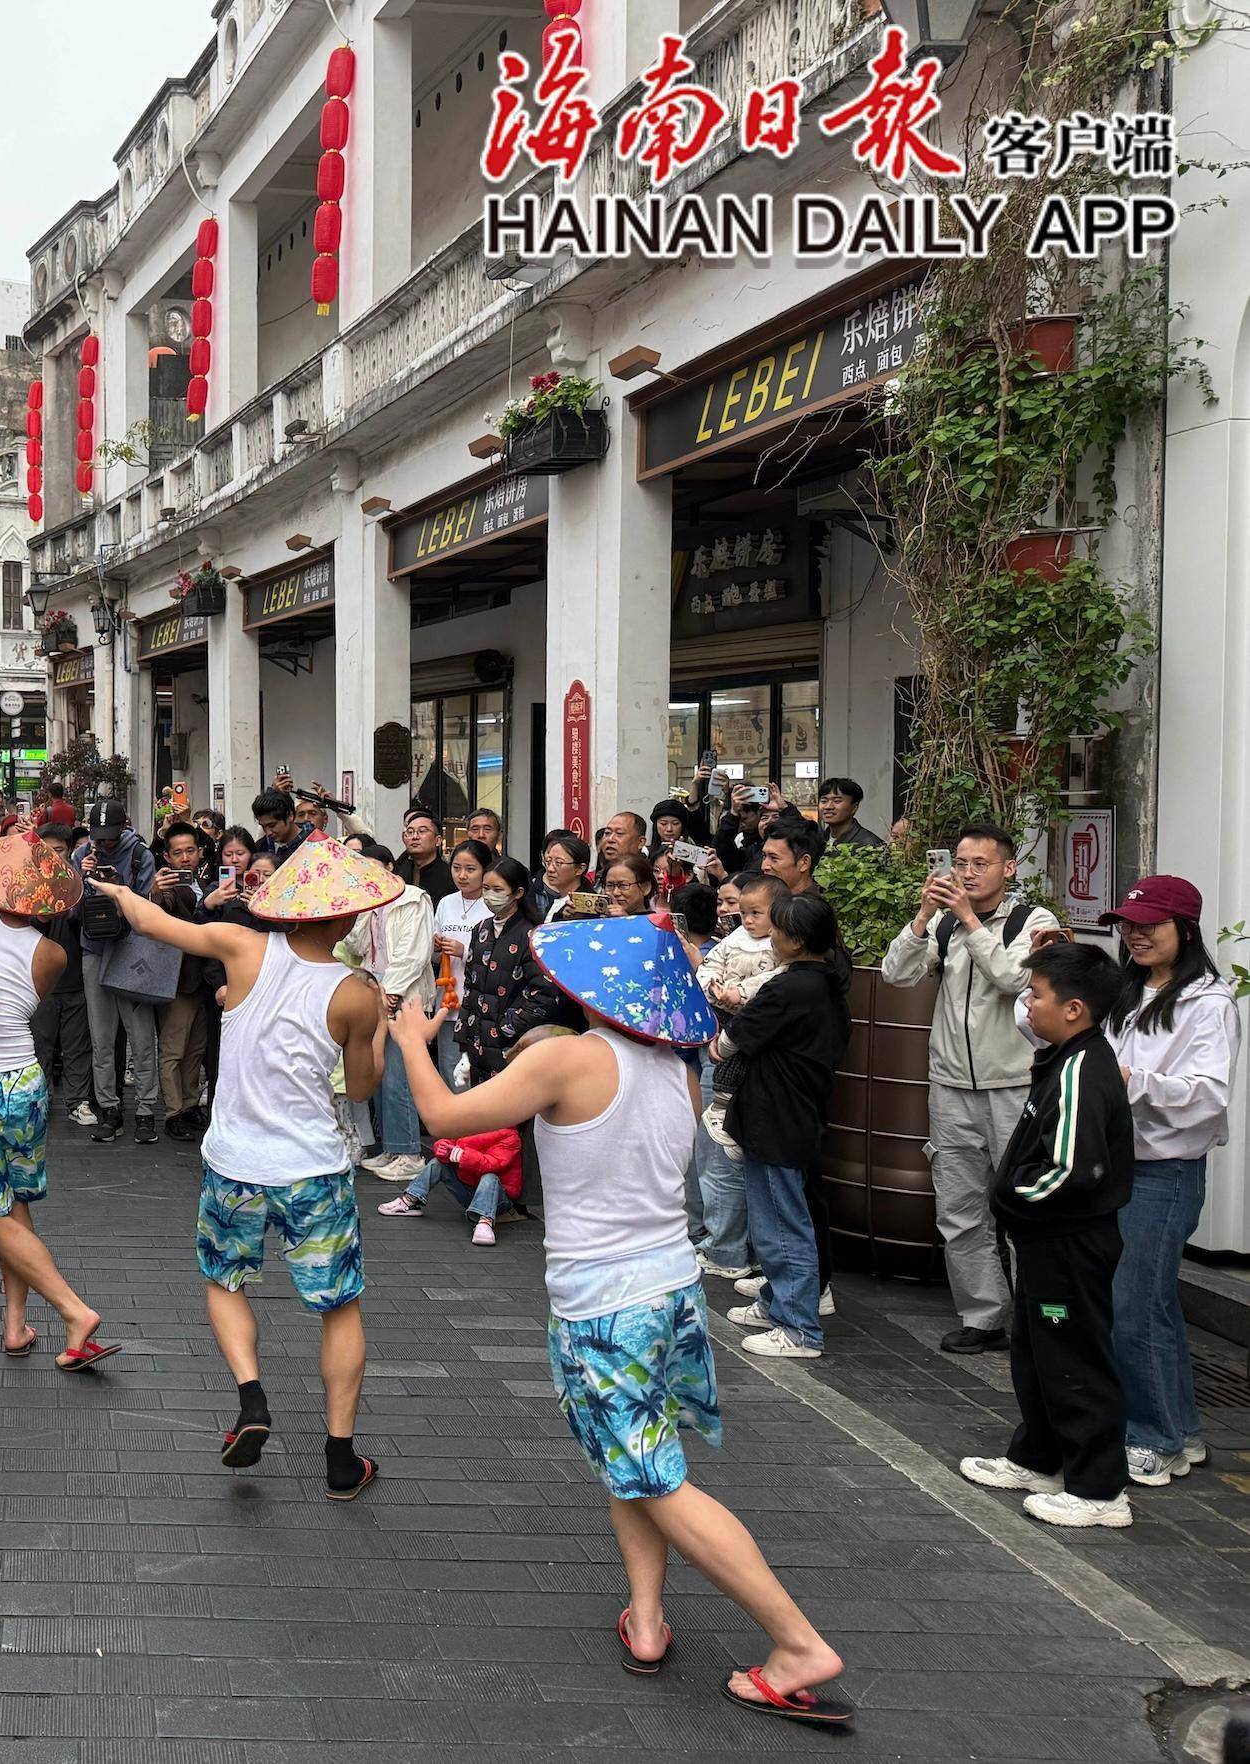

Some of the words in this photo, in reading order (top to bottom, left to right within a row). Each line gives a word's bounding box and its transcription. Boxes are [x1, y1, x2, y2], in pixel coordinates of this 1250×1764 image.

[842, 359, 867, 388] 西点
[876, 345, 904, 373] 面包
[696, 331, 825, 444] LEBEI
[484, 475, 528, 515] 乐焙饼房
[417, 496, 478, 557] LEBEI
[262, 574, 300, 615] LEBEI
[151, 618, 181, 649] LEBEI
[56, 659, 80, 683] LEBEI
